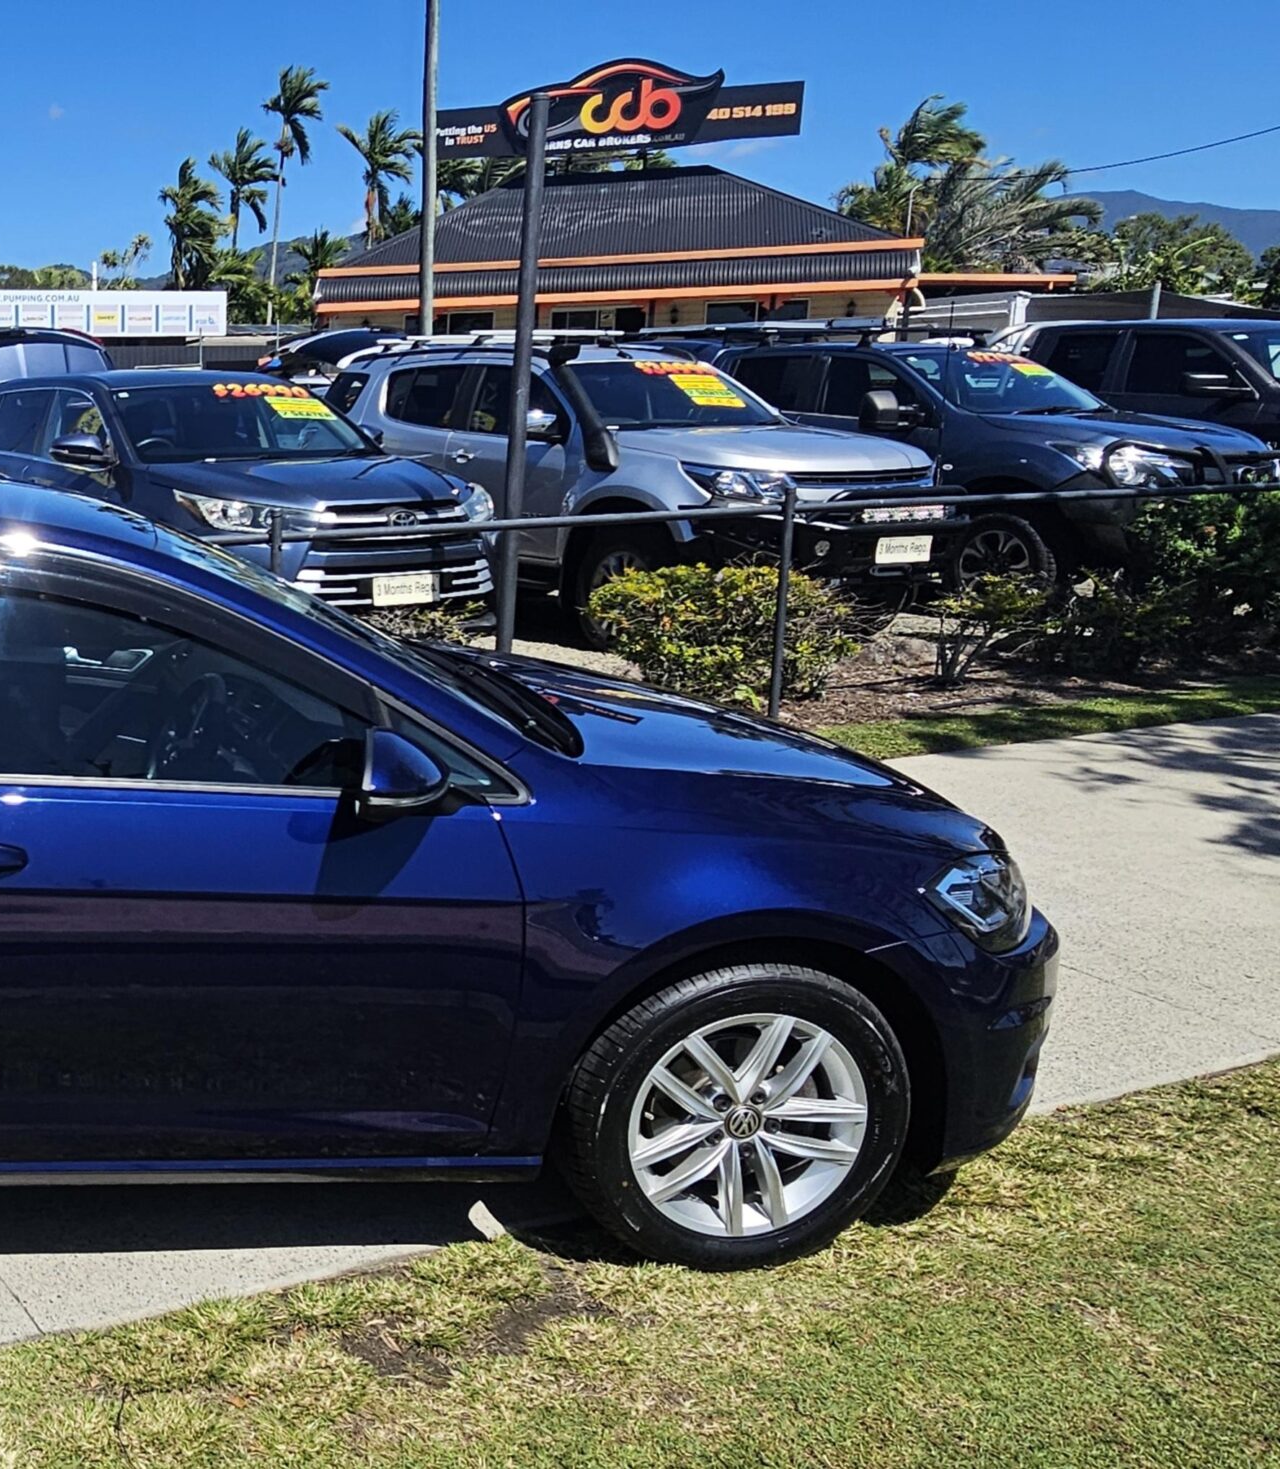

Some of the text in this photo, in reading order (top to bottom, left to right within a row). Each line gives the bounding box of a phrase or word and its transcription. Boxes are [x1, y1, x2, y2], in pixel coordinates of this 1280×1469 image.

[706, 102, 797, 120] 40 514 199
[467, 125, 483, 135] the
[484, 123, 497, 133] US
[456, 134, 485, 145] TRUST
[573, 138, 596, 149] CAR
[383, 583, 413, 596] Months
